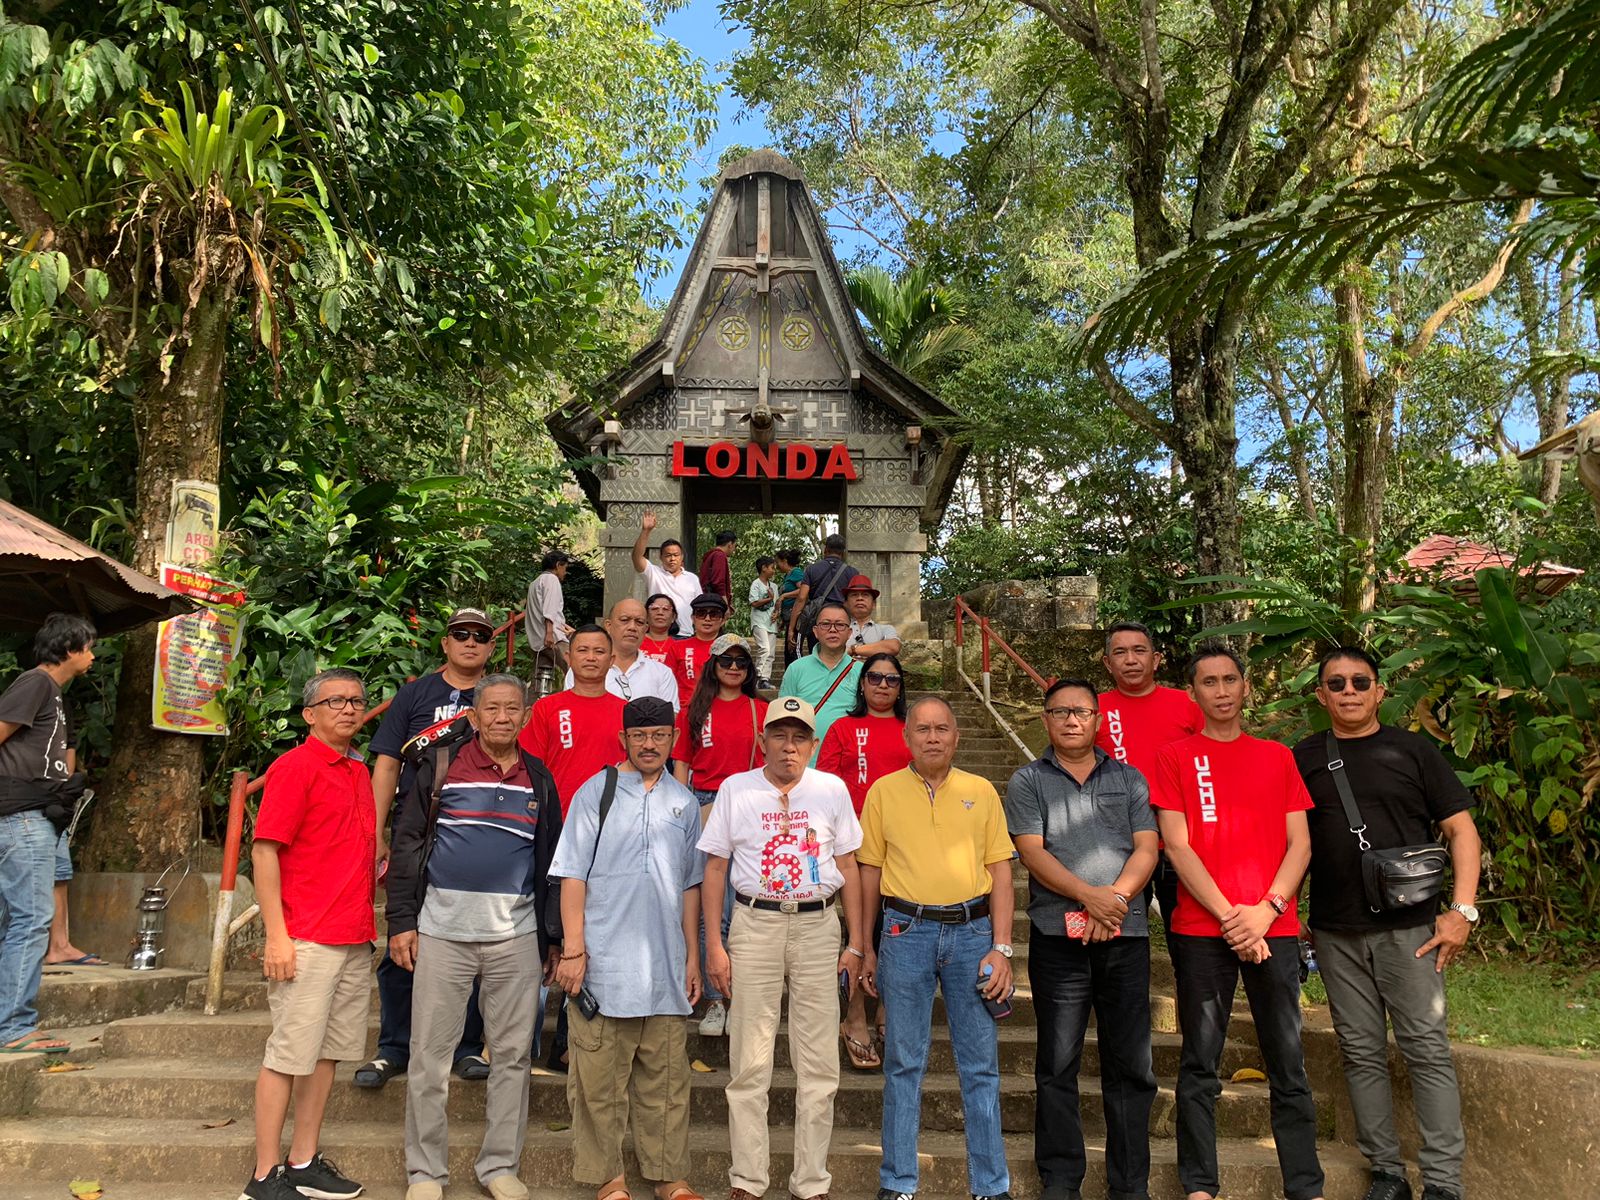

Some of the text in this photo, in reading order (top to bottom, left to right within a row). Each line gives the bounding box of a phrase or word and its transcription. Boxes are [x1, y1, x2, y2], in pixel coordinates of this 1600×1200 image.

[672, 441, 857, 480] LONDA
[183, 547, 213, 561] CCT
[184, 532, 214, 547] AREA
[559, 709, 573, 749] ROY
[1107, 709, 1128, 764] NOVD
[855, 727, 869, 785] WULAN
[1193, 755, 1218, 823] UCHE
